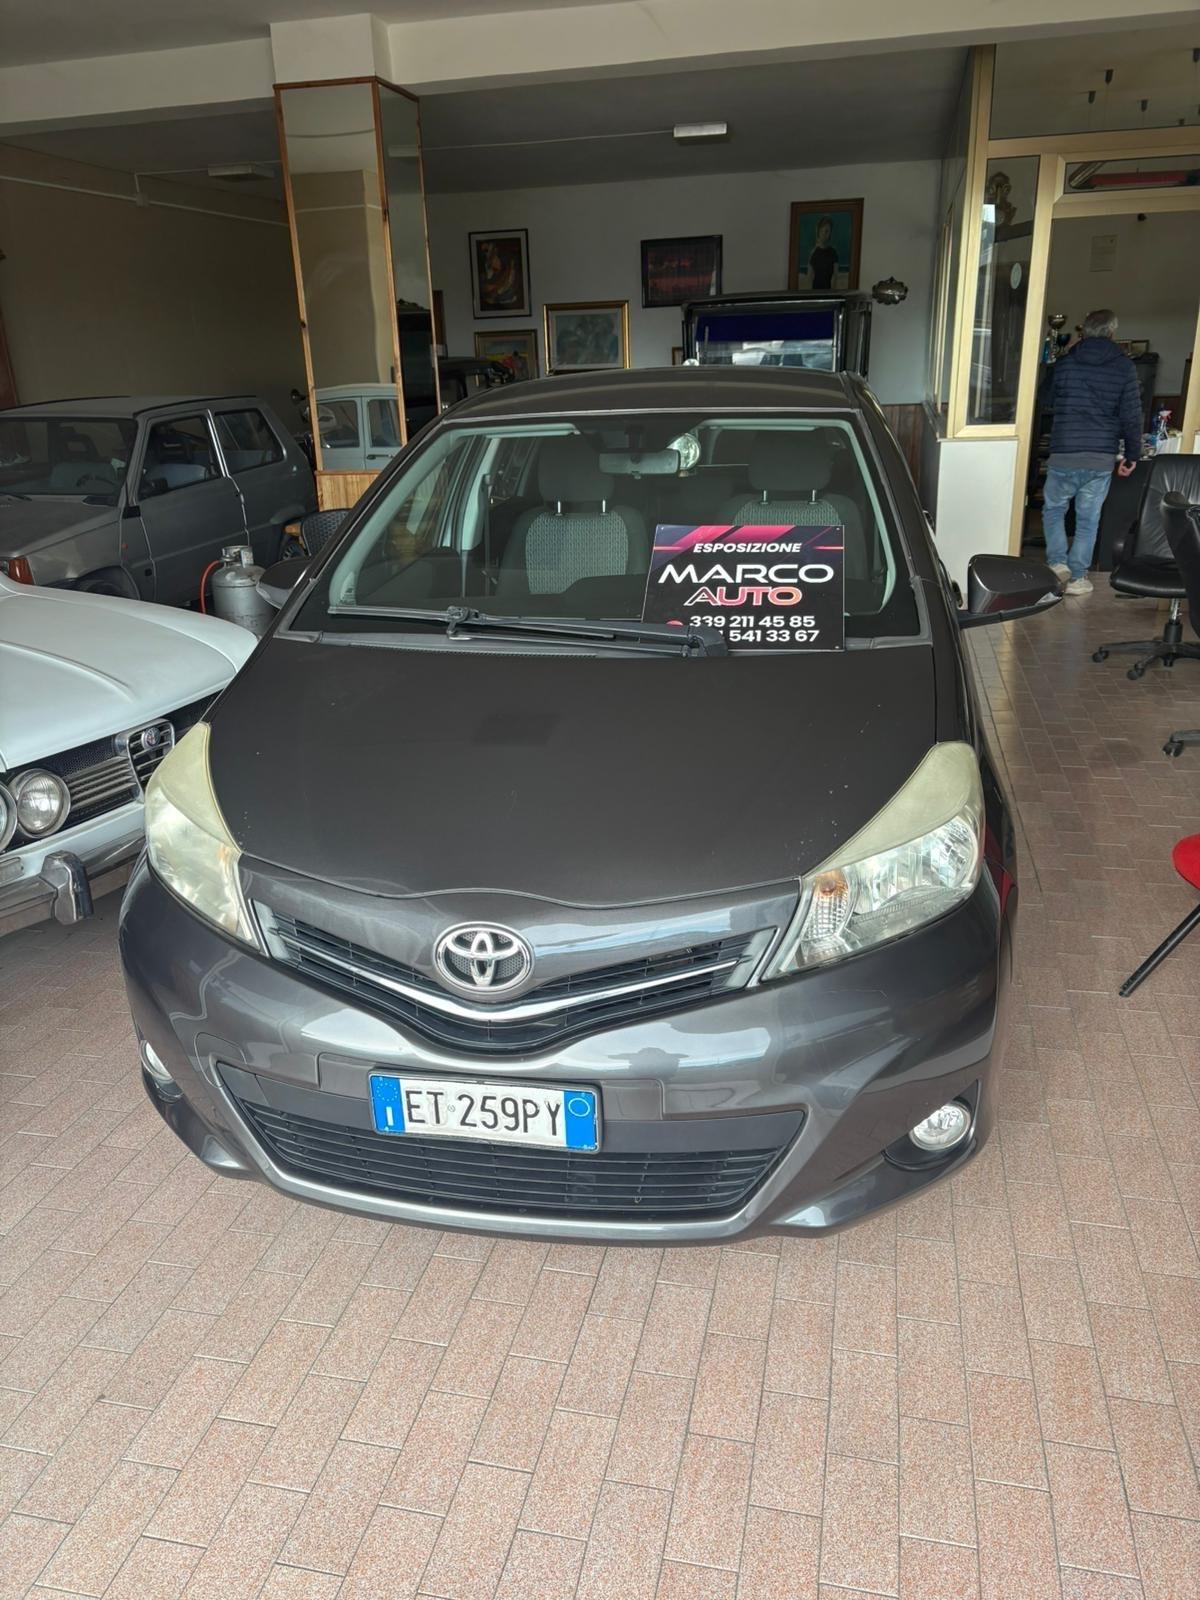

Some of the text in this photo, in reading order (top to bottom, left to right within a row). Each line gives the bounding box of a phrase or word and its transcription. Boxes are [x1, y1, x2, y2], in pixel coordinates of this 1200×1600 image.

[693, 542, 802, 553] ESPOSIZIONE
[658, 564, 834, 584] MARCO
[684, 586, 803, 606] AUTO
[729, 615, 755, 628] 211
[758, 615, 785, 628] 45
[789, 615, 816, 628] 85
[729, 629, 761, 642] 541
[766, 629, 790, 642] 33
[794, 629, 820, 642] 67
[405, 1090, 444, 1124] ET
[457, 1093, 561, 1136] 259PY
